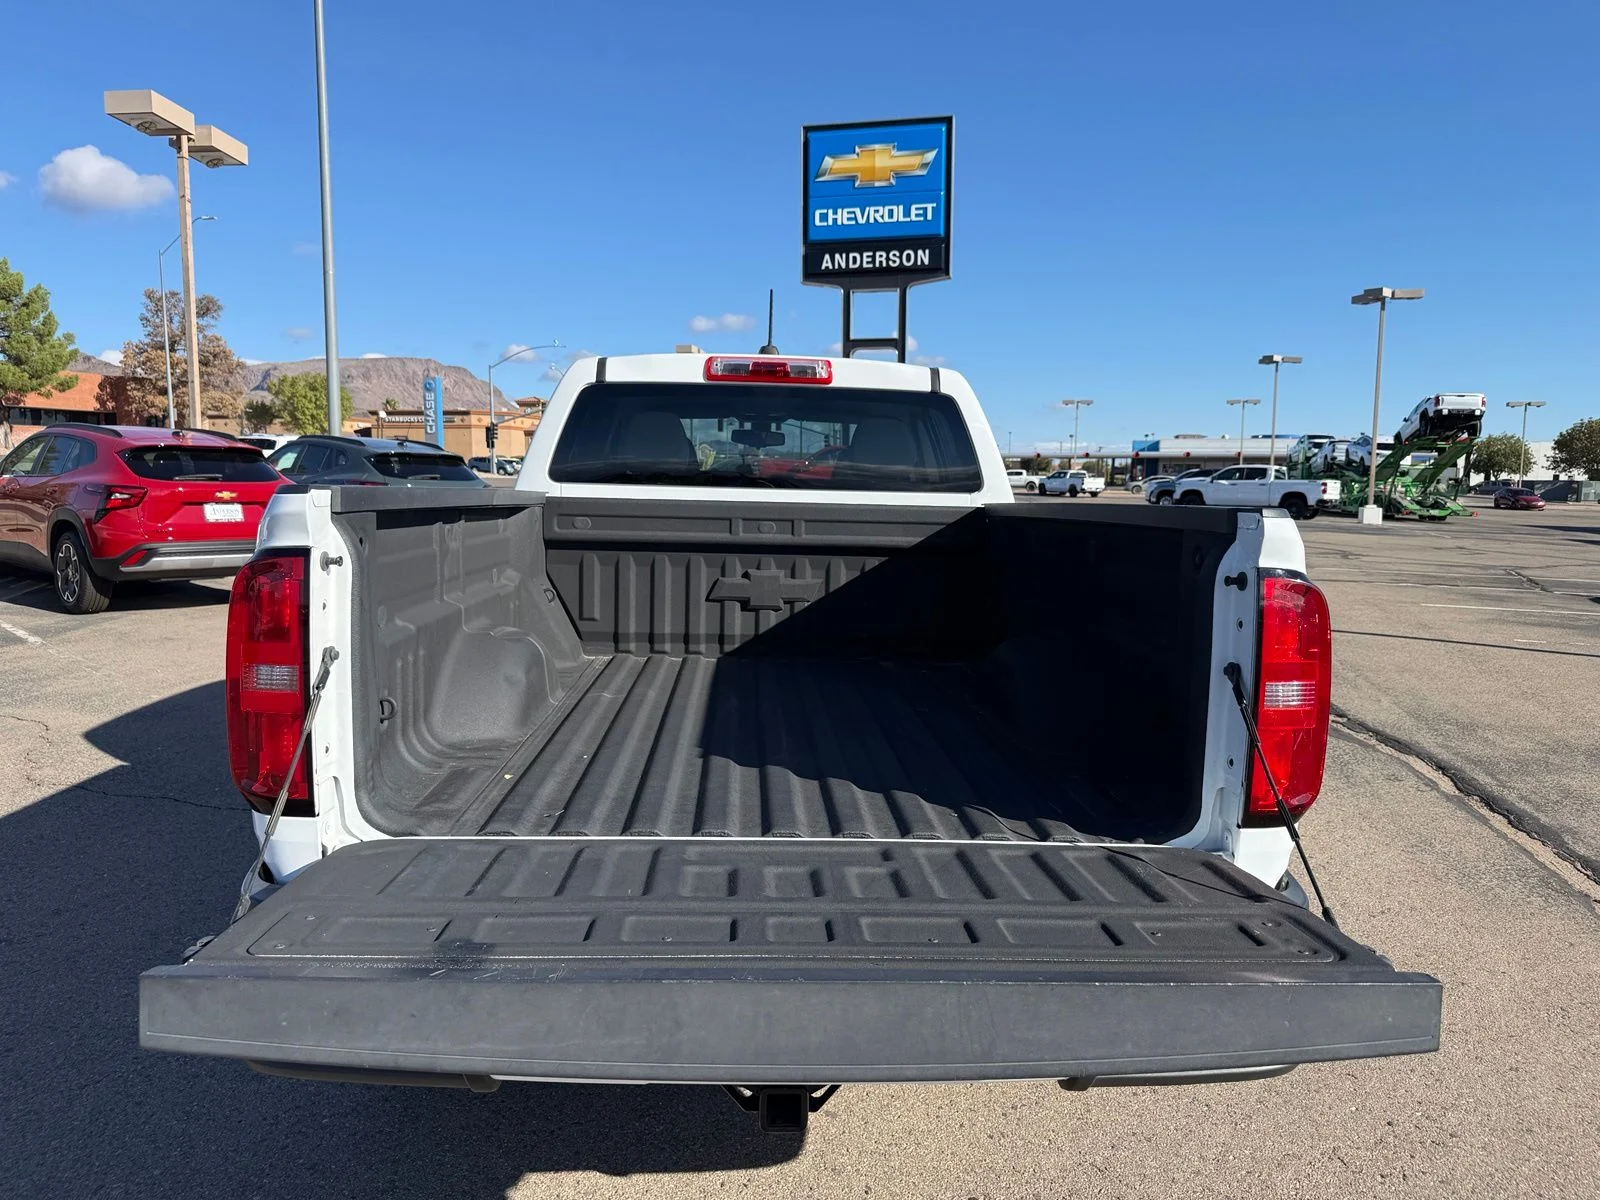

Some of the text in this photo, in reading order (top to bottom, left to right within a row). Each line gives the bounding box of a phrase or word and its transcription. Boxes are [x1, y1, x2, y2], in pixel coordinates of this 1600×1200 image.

[814, 203, 937, 227] CHEVROLET
[820, 249, 930, 270] ANDERSON
[425, 392, 436, 434] CHASE
